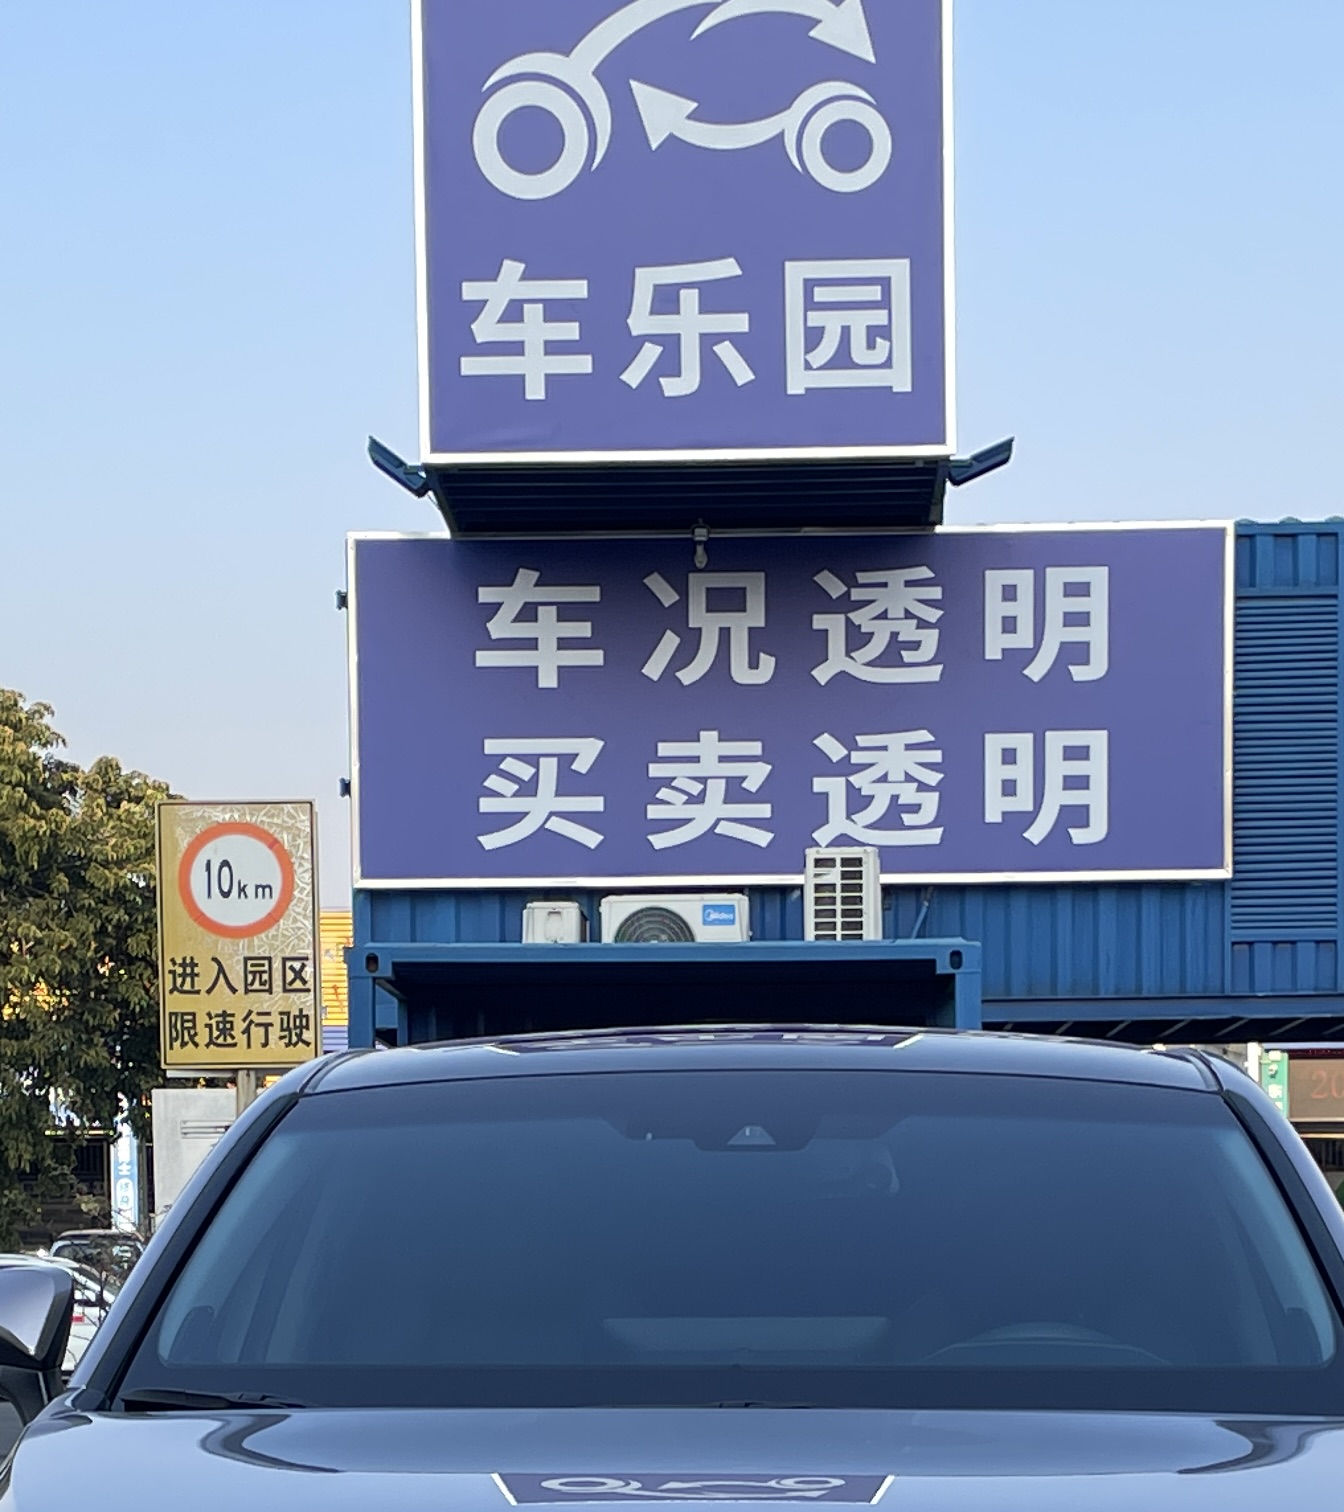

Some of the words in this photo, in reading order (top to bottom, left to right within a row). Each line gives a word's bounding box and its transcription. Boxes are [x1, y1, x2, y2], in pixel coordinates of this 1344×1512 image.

[460, 257, 913, 400] 车乐园
[474, 564, 1110, 690] 车况透明
[477, 729, 1110, 850] 买卖透明
[205, 859, 273, 900] 10km
[168, 955, 312, 996] 进入园区
[168, 1008, 312, 1050] 限速行驶
